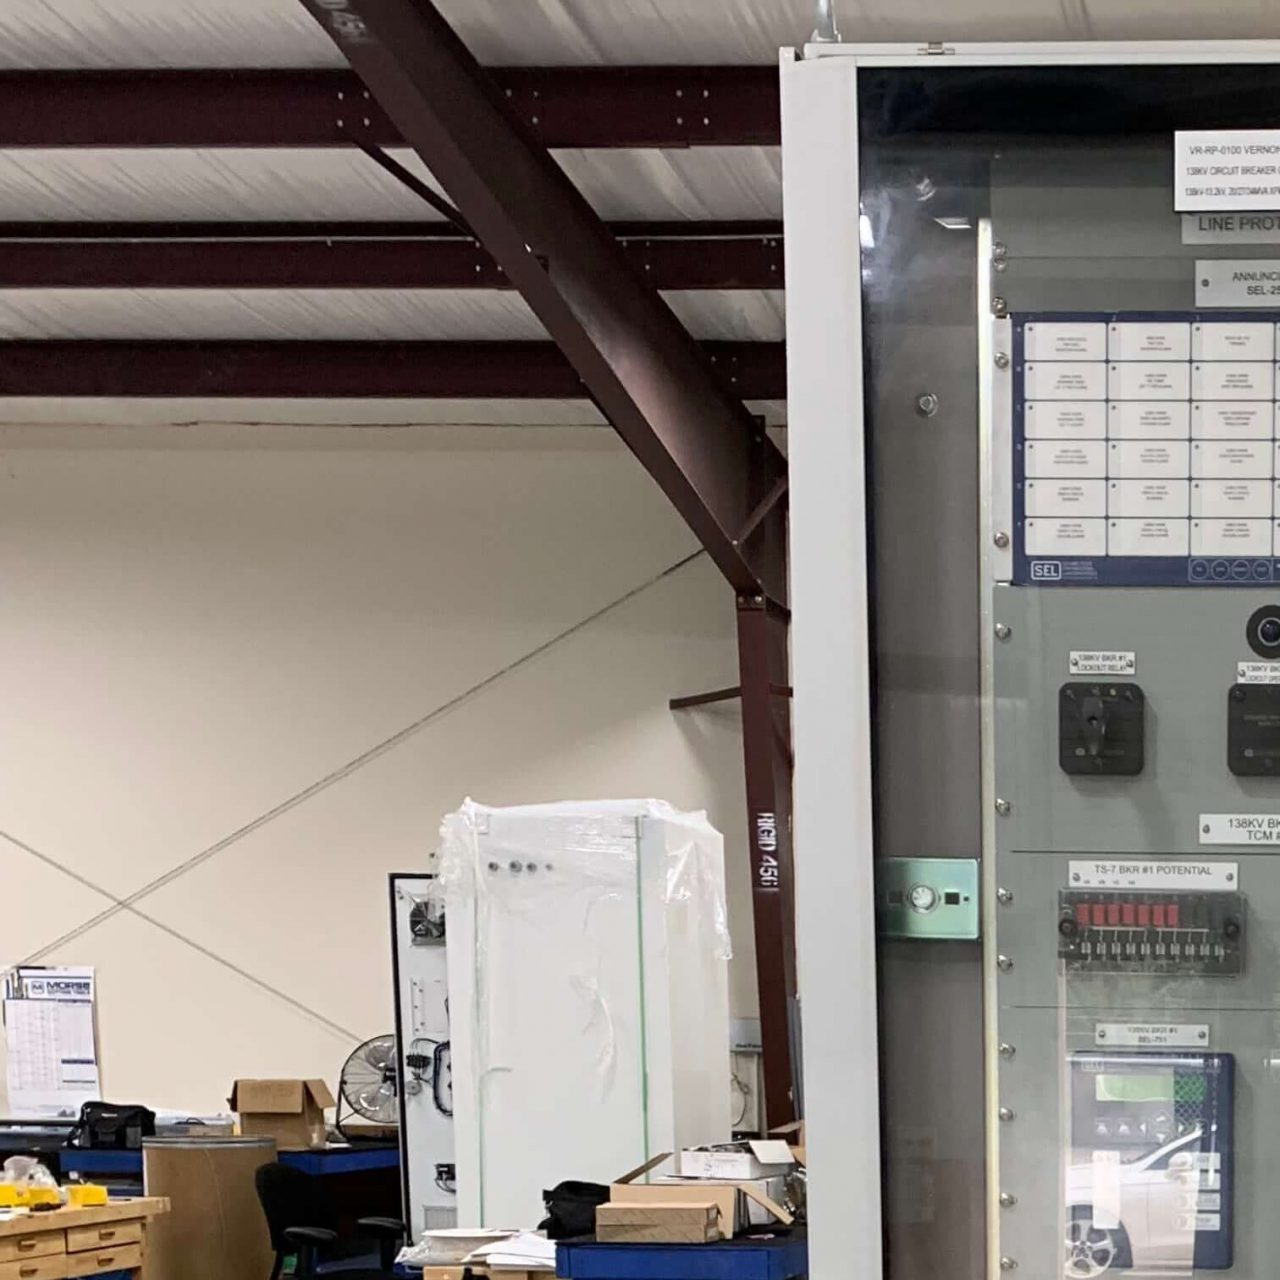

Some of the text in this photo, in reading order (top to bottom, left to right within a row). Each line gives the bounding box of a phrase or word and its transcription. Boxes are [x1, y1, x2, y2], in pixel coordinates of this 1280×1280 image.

[1210, 166, 1239, 176] CIRCUIT
[1241, 166, 1276, 176] BREAKER
[1198, 216, 1234, 232] LINE
[1034, 565, 1058, 578] SEL
[1228, 818, 1264, 828] 138KV
[756, 812, 776, 851] RIGID
[1246, 830, 1273, 841] TCM
[1094, 864, 1212, 876] TS-7 BKR #1 POTENTIAL
